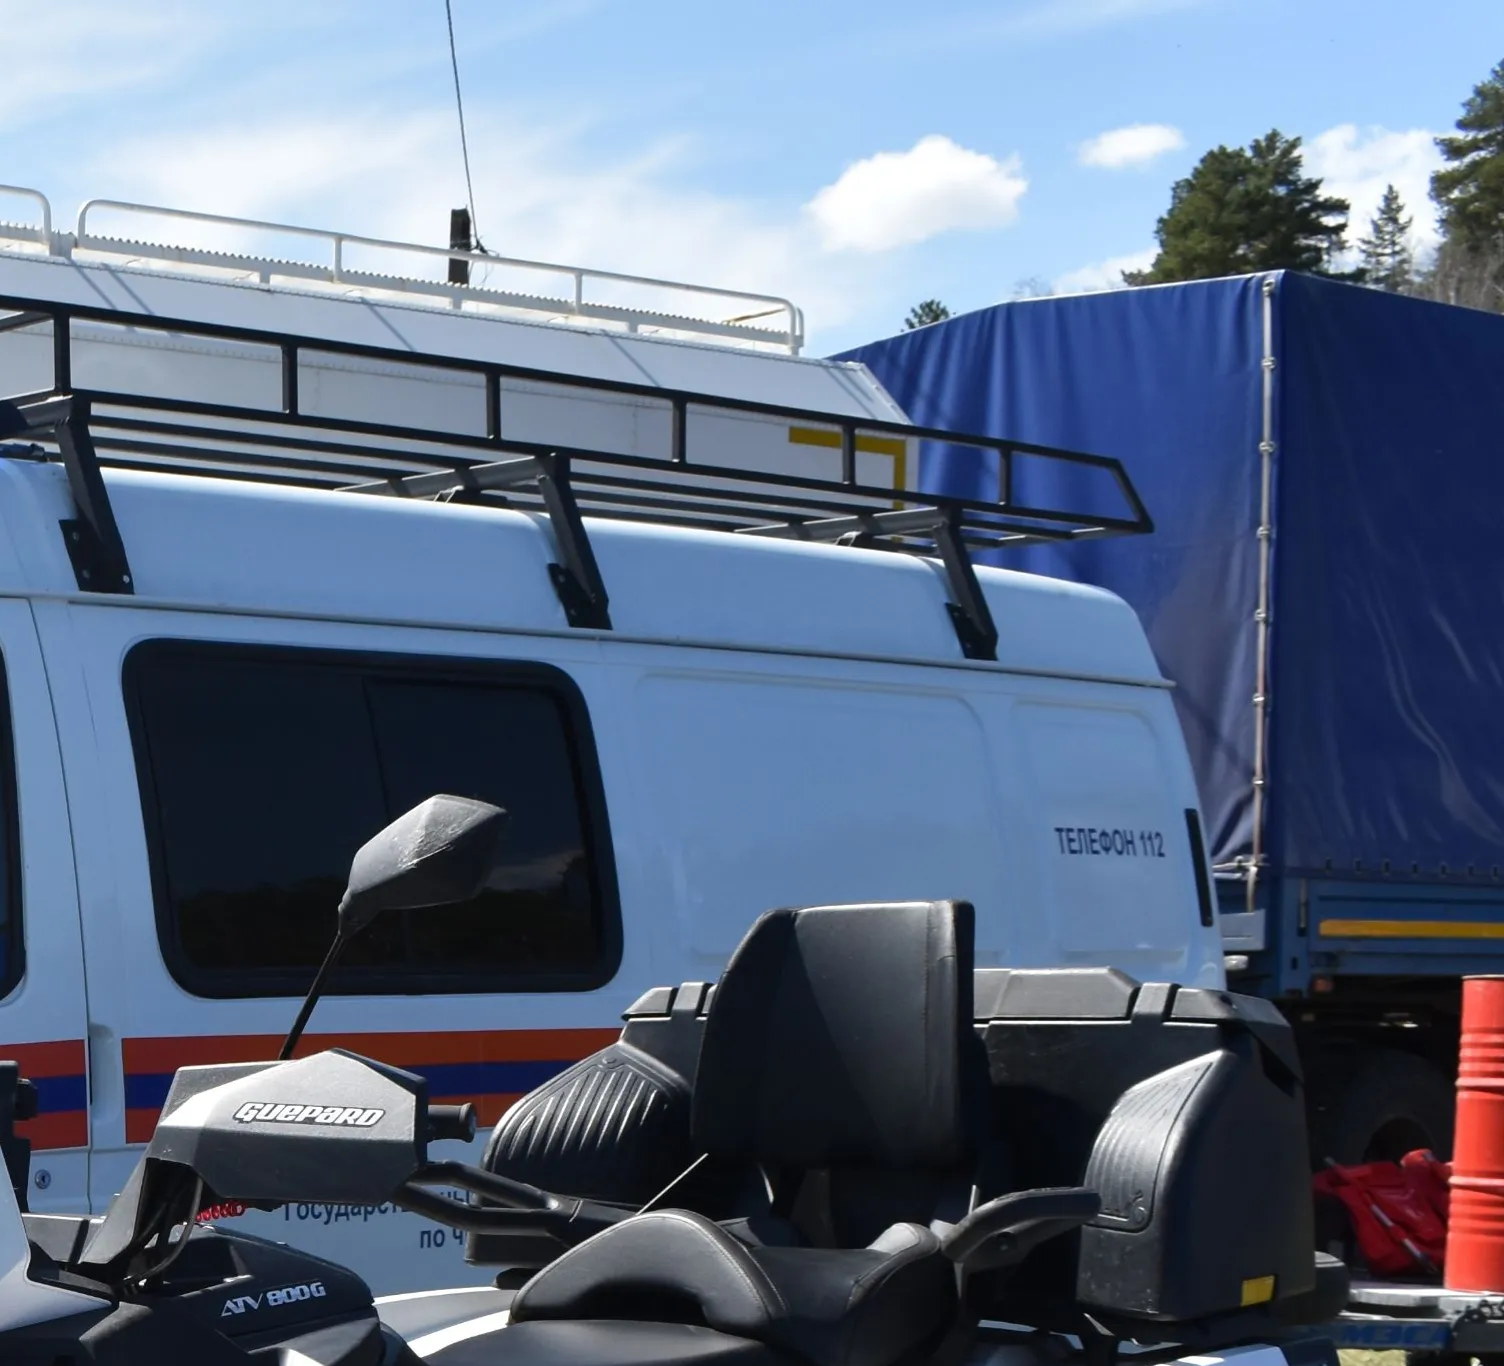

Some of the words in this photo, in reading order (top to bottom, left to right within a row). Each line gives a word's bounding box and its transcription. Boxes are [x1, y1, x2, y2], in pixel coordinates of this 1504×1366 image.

[1054, 827, 1137, 857] ТЕЛЕФОН
[1139, 831, 1166, 858] 112
[419, 1228, 446, 1249] по
[221, 1293, 263, 1317] ATV
[266, 1281, 326, 1307] 800G
